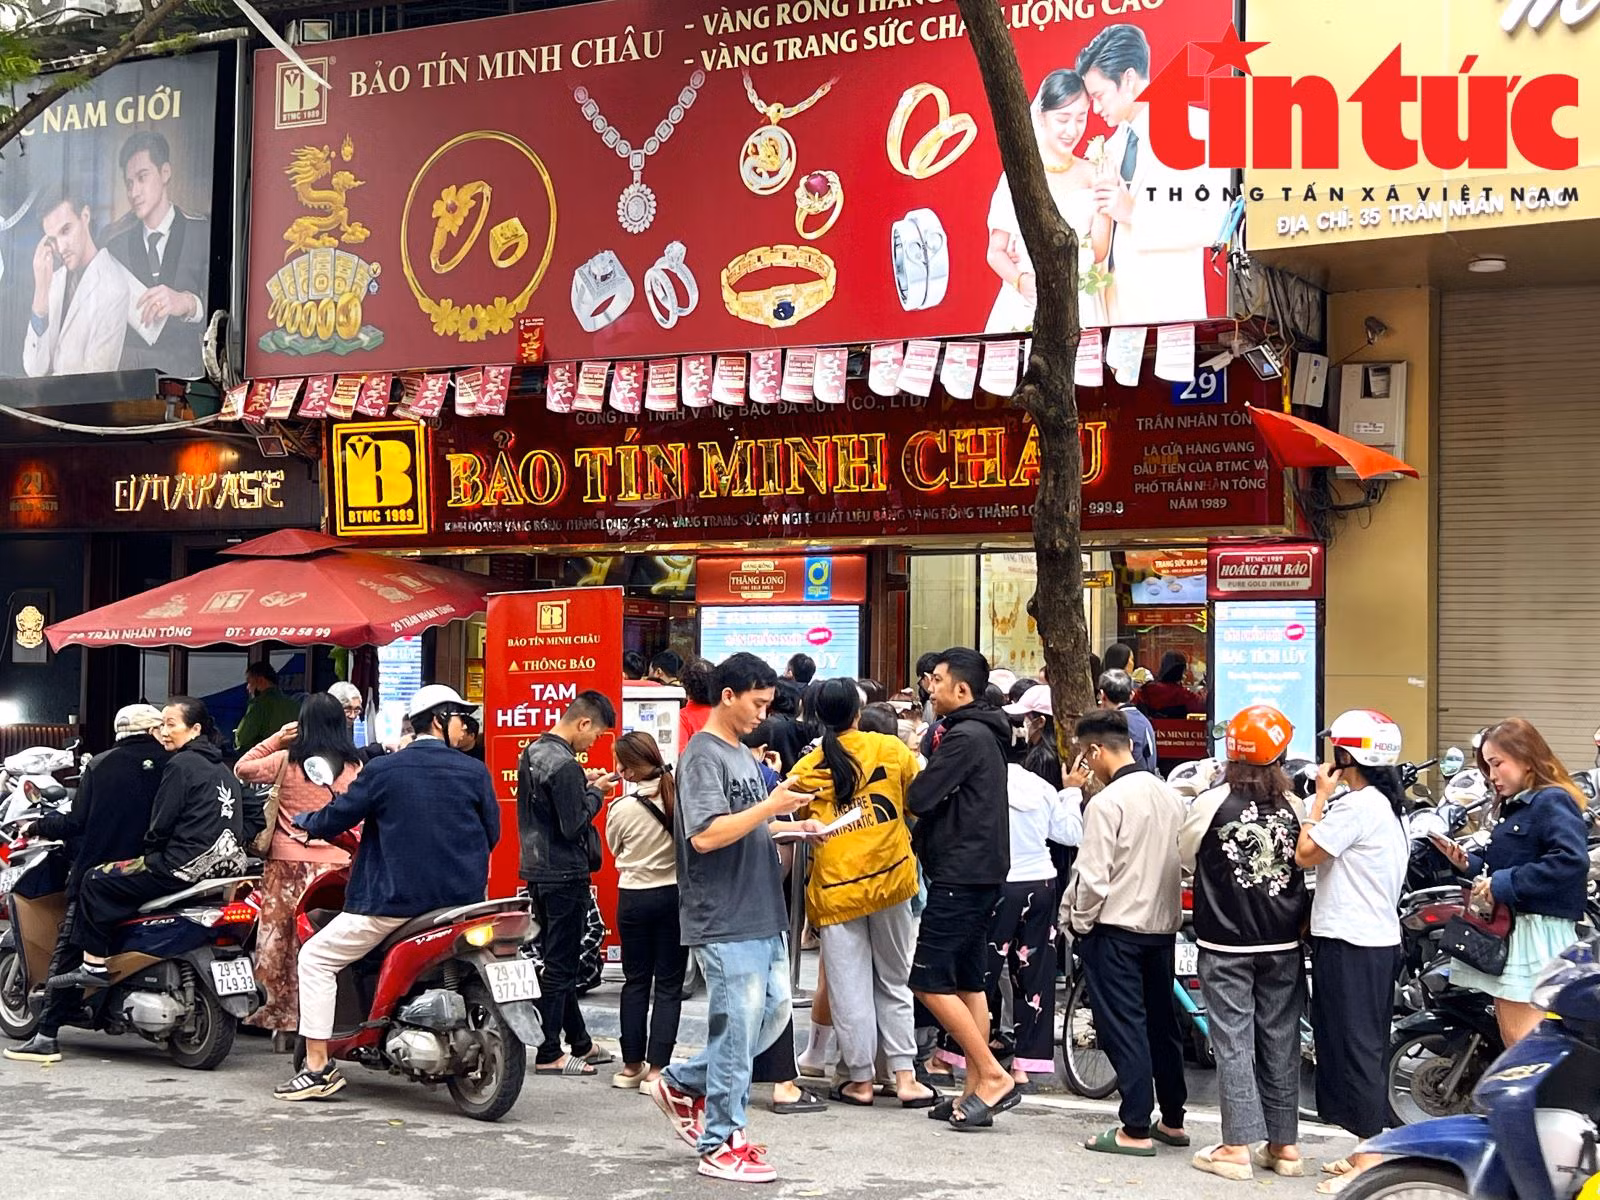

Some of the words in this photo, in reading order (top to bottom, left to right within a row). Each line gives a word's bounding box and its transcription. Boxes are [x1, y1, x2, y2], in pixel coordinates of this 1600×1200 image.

[702, 6, 770, 36] VÀNG
[701, 41, 768, 72] VÀNG
[773, 29, 858, 63] TRANG
[863, 17, 914, 49] SỨC
[920, 14, 968, 41] CH
[349, 60, 411, 98] BẢO
[418, 51, 469, 88] TÍN
[476, 44, 563, 82] MINH
[571, 25, 664, 69] CHÂU
[42, 100, 107, 134] NAM
[115, 84, 182, 125] GIỚI
[1277, 216, 1309, 239] ĐỊA
[1316, 209, 1353, 230] CHỈ:
[1360, 207, 1382, 227] 35
[1388, 199, 1442, 224] TRẦN
[1448, 191, 1504, 219] NHÂN
[1180, 371, 1217, 400] 29
[692, 405, 733, 421] VNG
[739, 402, 771, 420] BẠC
[1177, 410, 1218, 429] NHÂN
[1221, 408, 1252, 426] TÔN
[1144, 443, 1159, 457] LÀ
[1185, 440, 1221, 455] HÀNG
[445, 429, 563, 508] BẢO
[574, 427, 683, 503] TÍN
[697, 431, 887, 499] MINH
[1188, 458, 1213, 474] CỦA
[1215, 459, 1251, 473] BTMC
[1253, 456, 1269, 471] VÀ
[1134, 477, 1159, 494] PHỐ
[1231, 476, 1267, 490] TÔNG
[1169, 495, 1199, 510] NĂM
[1201, 497, 1228, 509] 1989
[349, 509, 382, 523] BTMC
[385, 508, 414, 523] 1989
[702, 514, 738, 528] TRANG
[1089, 501, 1125, 515] 999.9
[1220, 561, 1260, 577] HOÀNG
[1260, 563, 1282, 576] KIM
[1284, 560, 1308, 576] BẢO
[731, 574, 760, 585] THĂNG
[761, 575, 784, 585] LONG
[1227, 580, 1246, 588] PURE
[1247, 580, 1268, 588] GOLD
[1269, 580, 1300, 588] JEWELRY
[122, 626, 157, 640] NHÂN
[159, 625, 193, 638] TÔNG
[225, 626, 247, 638] ĐT:
[249, 626, 279, 637] 1800
[315, 626, 332, 638] 99
[528, 635, 545, 646] TÍN
[546, 635, 572, 645] MINH
[573, 633, 601, 644] CHÂU
[522, 657, 567, 671] THÔNG
[569, 655, 596, 670] BÁO
[530, 683, 577, 705] TẠM
[496, 702, 541, 728] HẾT
[1237, 744, 1257, 753] Food
[142, 918, 176, 927] LEAD
[217, 961, 248, 977] 29-E1
[494, 963, 527, 982] 29-V7
[1178, 959, 1198, 973] 46
[217, 975, 255, 993] 749.33
[494, 979, 535, 999] 372.47
